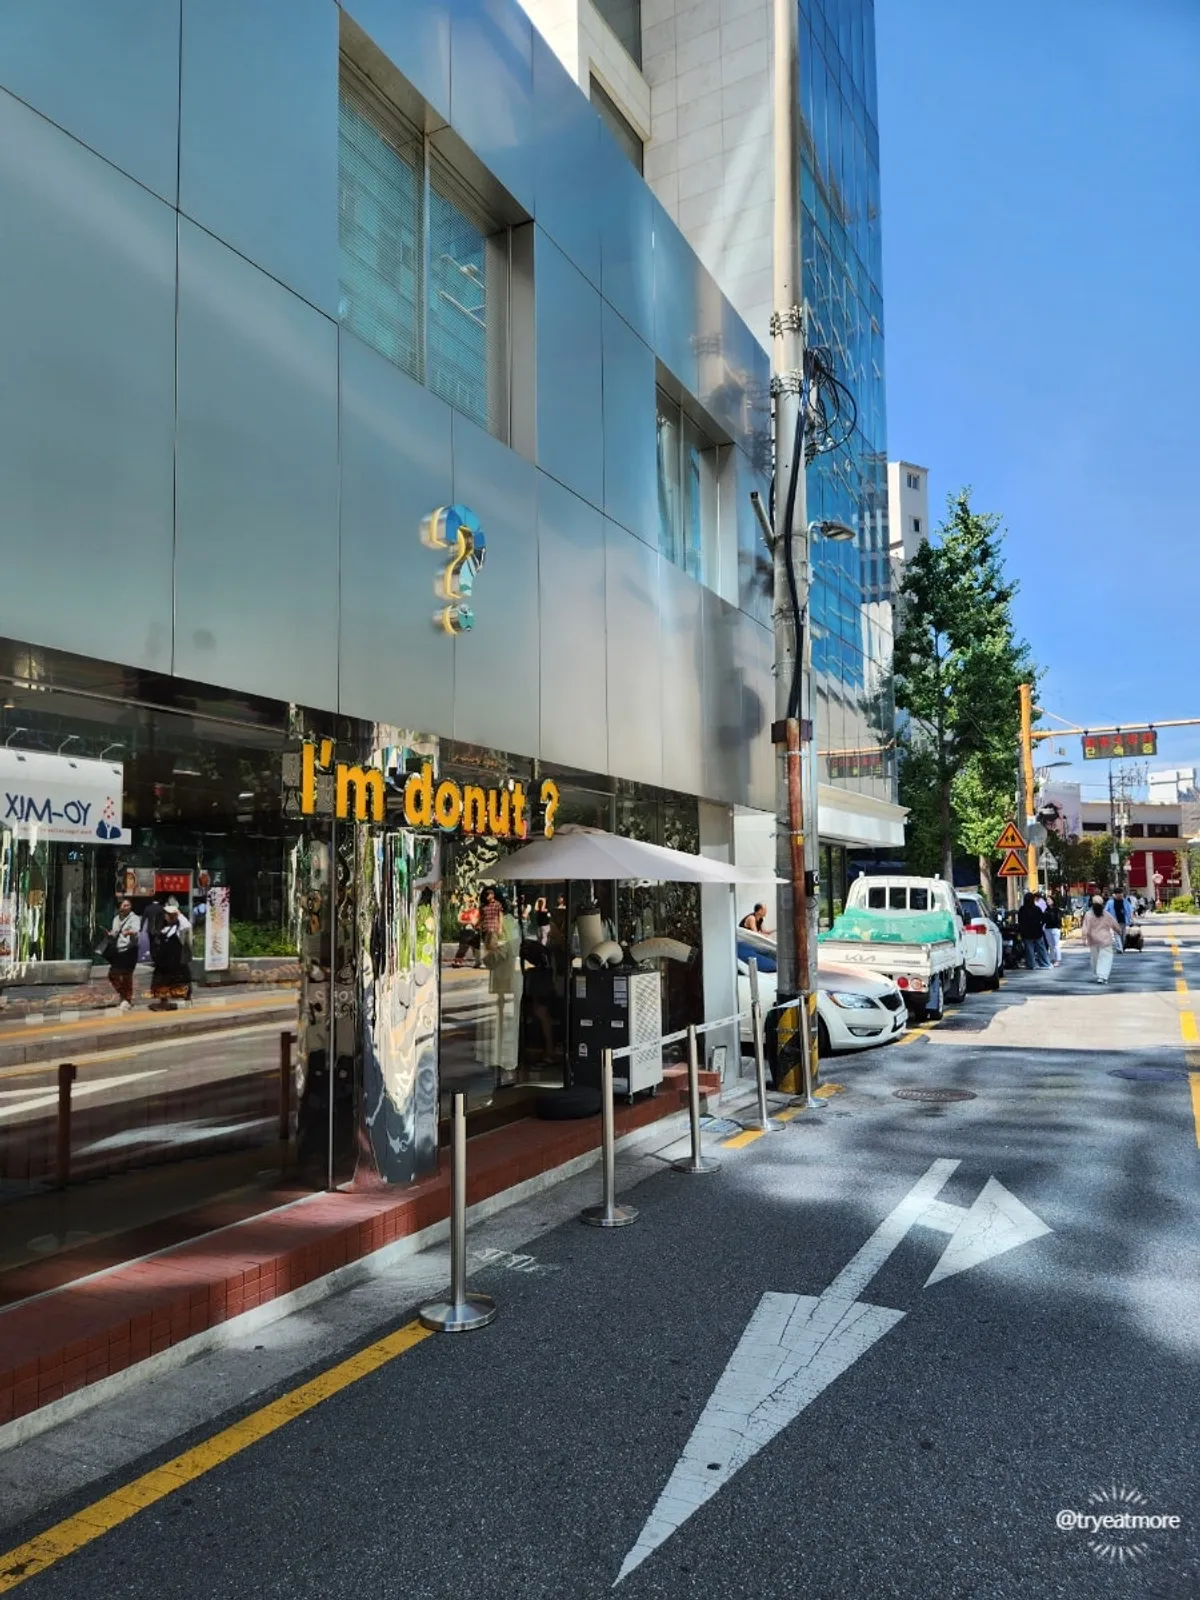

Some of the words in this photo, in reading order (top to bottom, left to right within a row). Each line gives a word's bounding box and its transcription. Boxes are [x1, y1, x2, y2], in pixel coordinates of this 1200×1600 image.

[424, 504, 487, 637] ?
[301, 738, 385, 823] I'm
[403, 761, 527, 839] donut
[540, 778, 560, 840] ?
